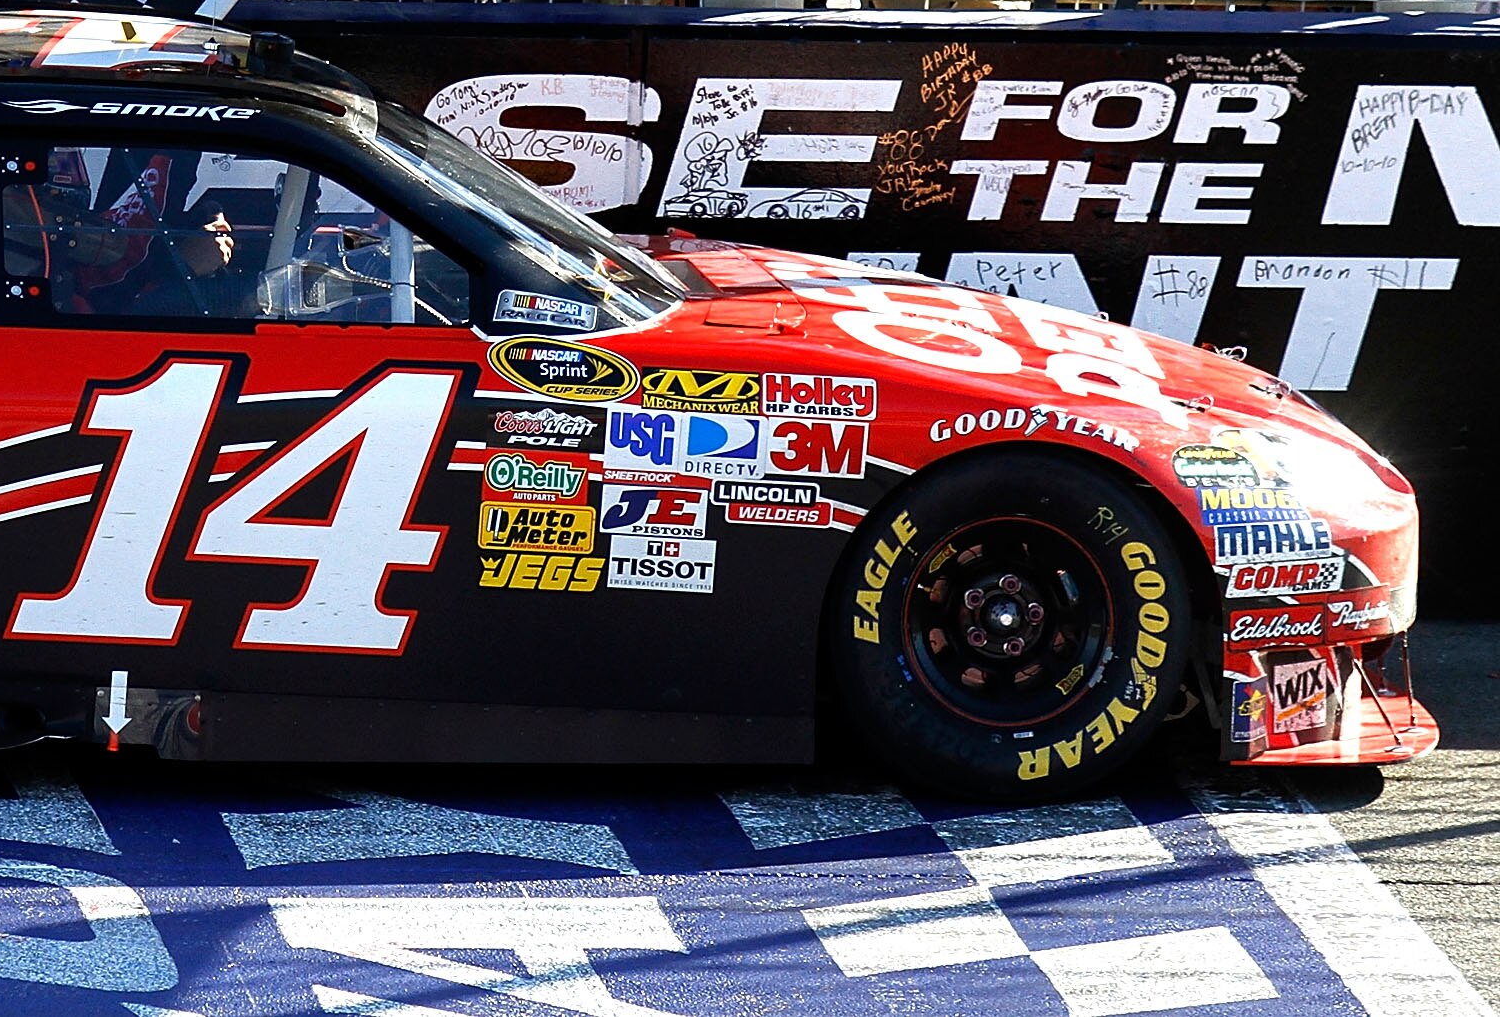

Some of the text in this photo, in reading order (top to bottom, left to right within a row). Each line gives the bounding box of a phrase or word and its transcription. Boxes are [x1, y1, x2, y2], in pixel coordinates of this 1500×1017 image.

[961, 79, 1290, 145] FOR
[1359, 89, 1405, 118] HAPPY
[1351, 113, 1397, 153] BRETT
[949, 160, 1264, 225] THE
[975, 260, 1061, 284] Peter
[1254, 262, 1350, 282] Brandon
[534, 298, 580, 316] NASCAR
[531, 349, 581, 362] NASCAR
[540, 362, 588, 378] Sprint
[546, 386, 620, 396] CUP SERIES
[766, 375, 874, 417] Holley
[643, 394, 759, 414] MECHANIX WEAR
[766, 403, 854, 417] HP CARBS
[494, 410, 598, 436] Coors LIGHT
[507, 435, 582, 448] POLE
[609, 411, 675, 466] USG
[770, 421, 865, 475] 3M
[491, 455, 580, 495] O'Reilly
[604, 469, 674, 483] SHEETROCK
[684, 460, 756, 476] DIRECTV
[513, 492, 556, 502] AUTO PARTS
[718, 484, 811, 504] LINCOLN
[6, 358, 450, 655] 14
[512, 508, 576, 528] Auto
[601, 490, 702, 530] JE
[738, 506, 820, 523] WELDERS
[510, 526, 588, 545] Meter
[632, 525, 704, 537] PISTONS
[1217, 521, 1330, 557] MAHLE
[479, 553, 606, 592] JEGS
[611, 557, 713, 580] TISSOT
[854, 510, 918, 644] EAGLE
[1234, 563, 1320, 591] COMP
[1292, 581, 1330, 592] CAMS
[1231, 613, 1322, 641] Edelbrock
[1275, 663, 1324, 710] WIX
